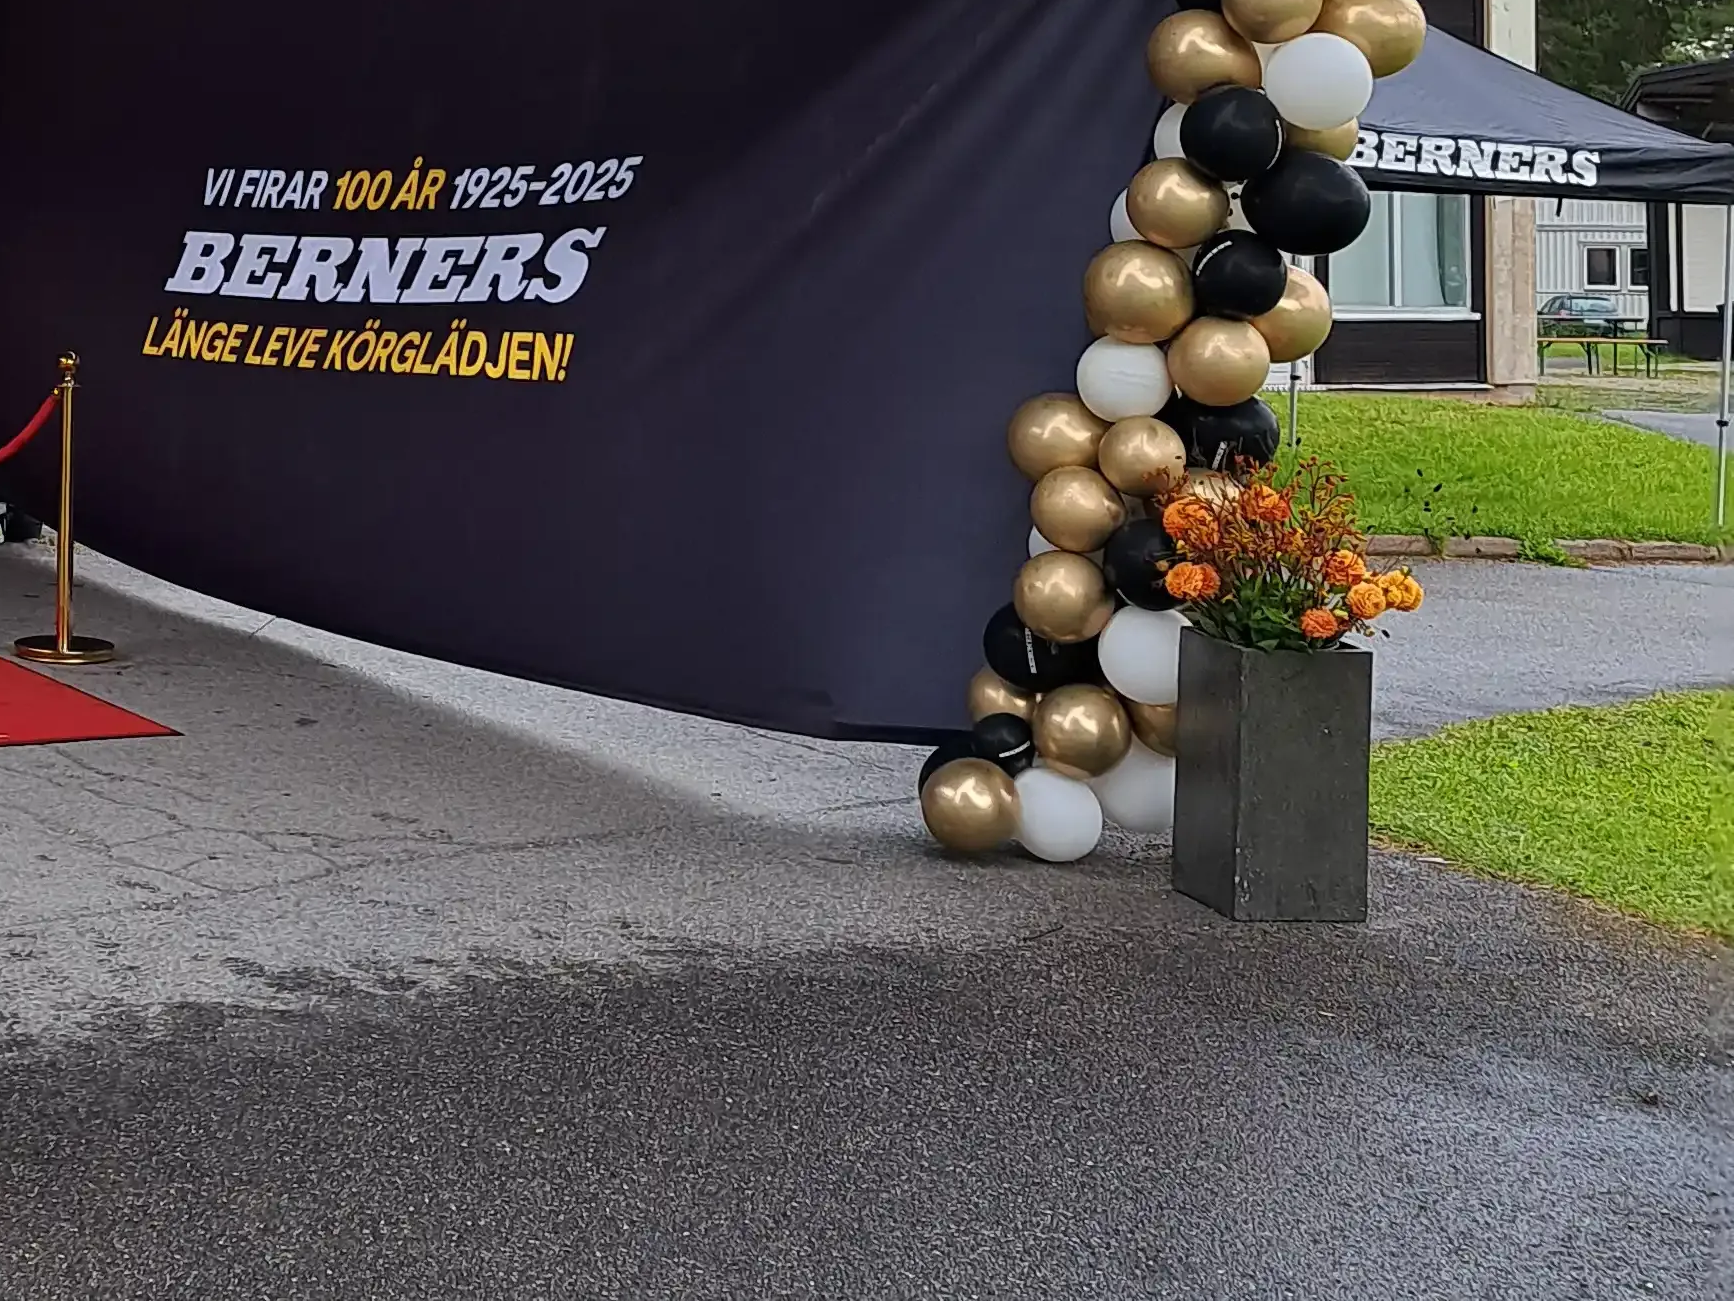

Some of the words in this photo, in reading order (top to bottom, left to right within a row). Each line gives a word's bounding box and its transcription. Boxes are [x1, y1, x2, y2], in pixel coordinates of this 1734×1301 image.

[203, 167, 235, 207] VI
[233, 168, 329, 210] FIRAR
[332, 169, 393, 210] 100
[390, 156, 446, 210] ÅR
[449, 155, 644, 210] 1925-2025
[1345, 129, 1602, 188] BERNERS
[164, 226, 608, 304] BERNERS
[142, 307, 247, 363] LÄNGE
[244, 326, 327, 369] LEVE
[322, 318, 575, 381] KÖRGLÄDJEN!
